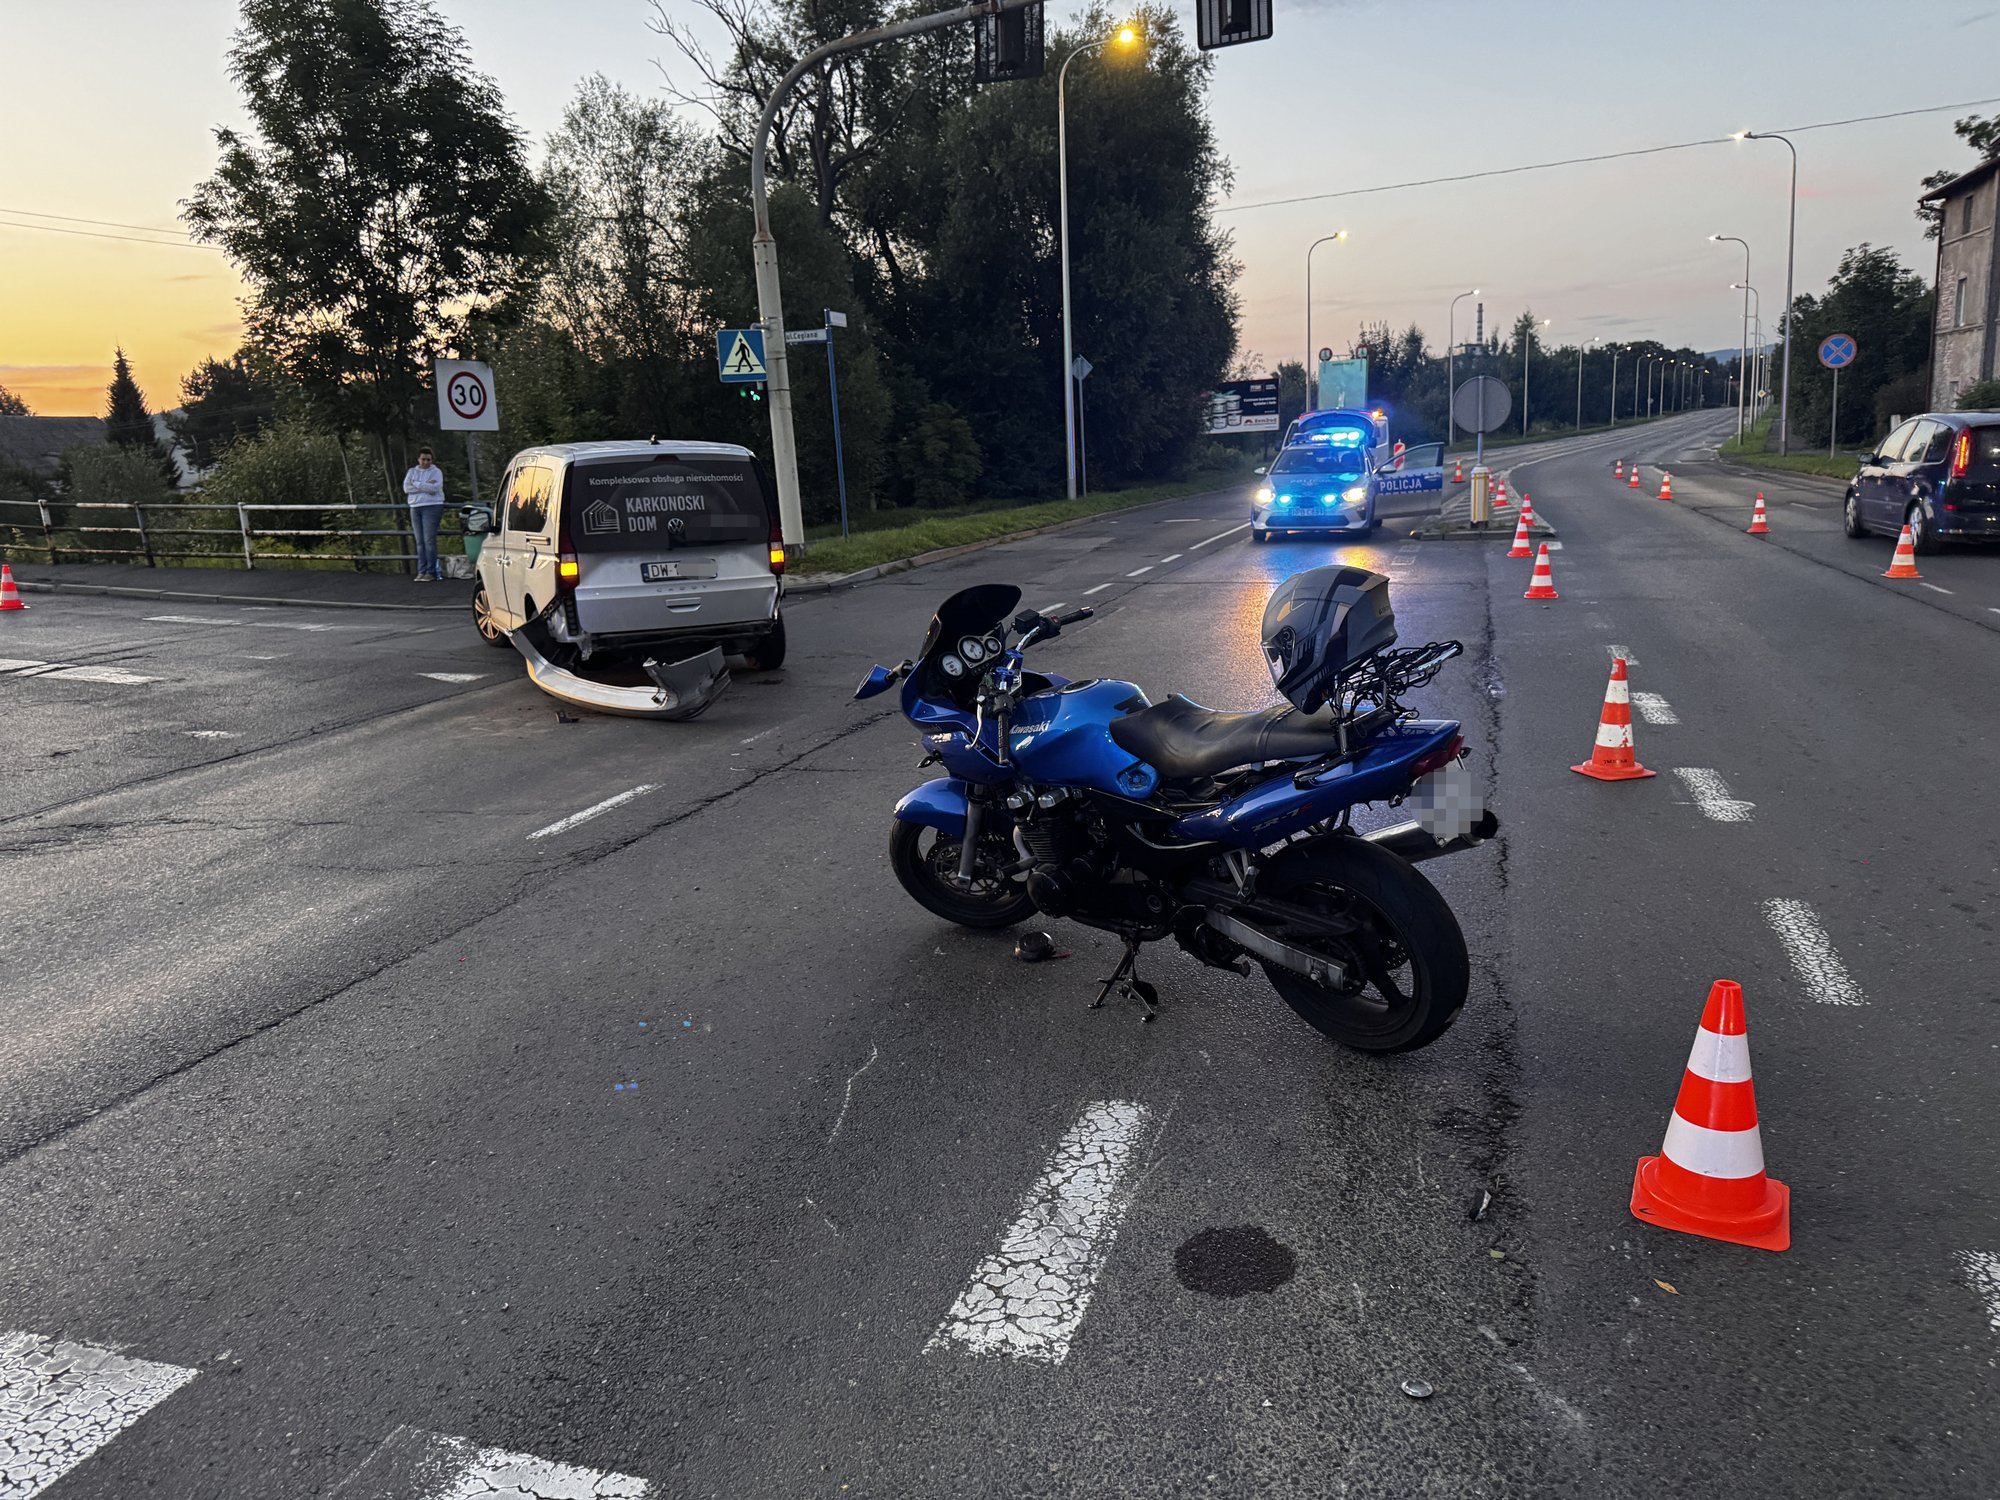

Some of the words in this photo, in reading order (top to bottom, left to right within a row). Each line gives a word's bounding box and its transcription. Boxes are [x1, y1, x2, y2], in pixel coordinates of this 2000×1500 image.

[454, 384, 482, 406] 30
[589, 476, 650, 486] Kompleksowa
[652, 474, 684, 484] obsługa
[686, 473, 744, 482] nieruchomości
[1380, 478, 1422, 491] POLICJA
[625, 495, 705, 513] KARKONOSKI
[628, 516, 657, 532] DOM
[1009, 720, 1051, 735] Kawasaki
